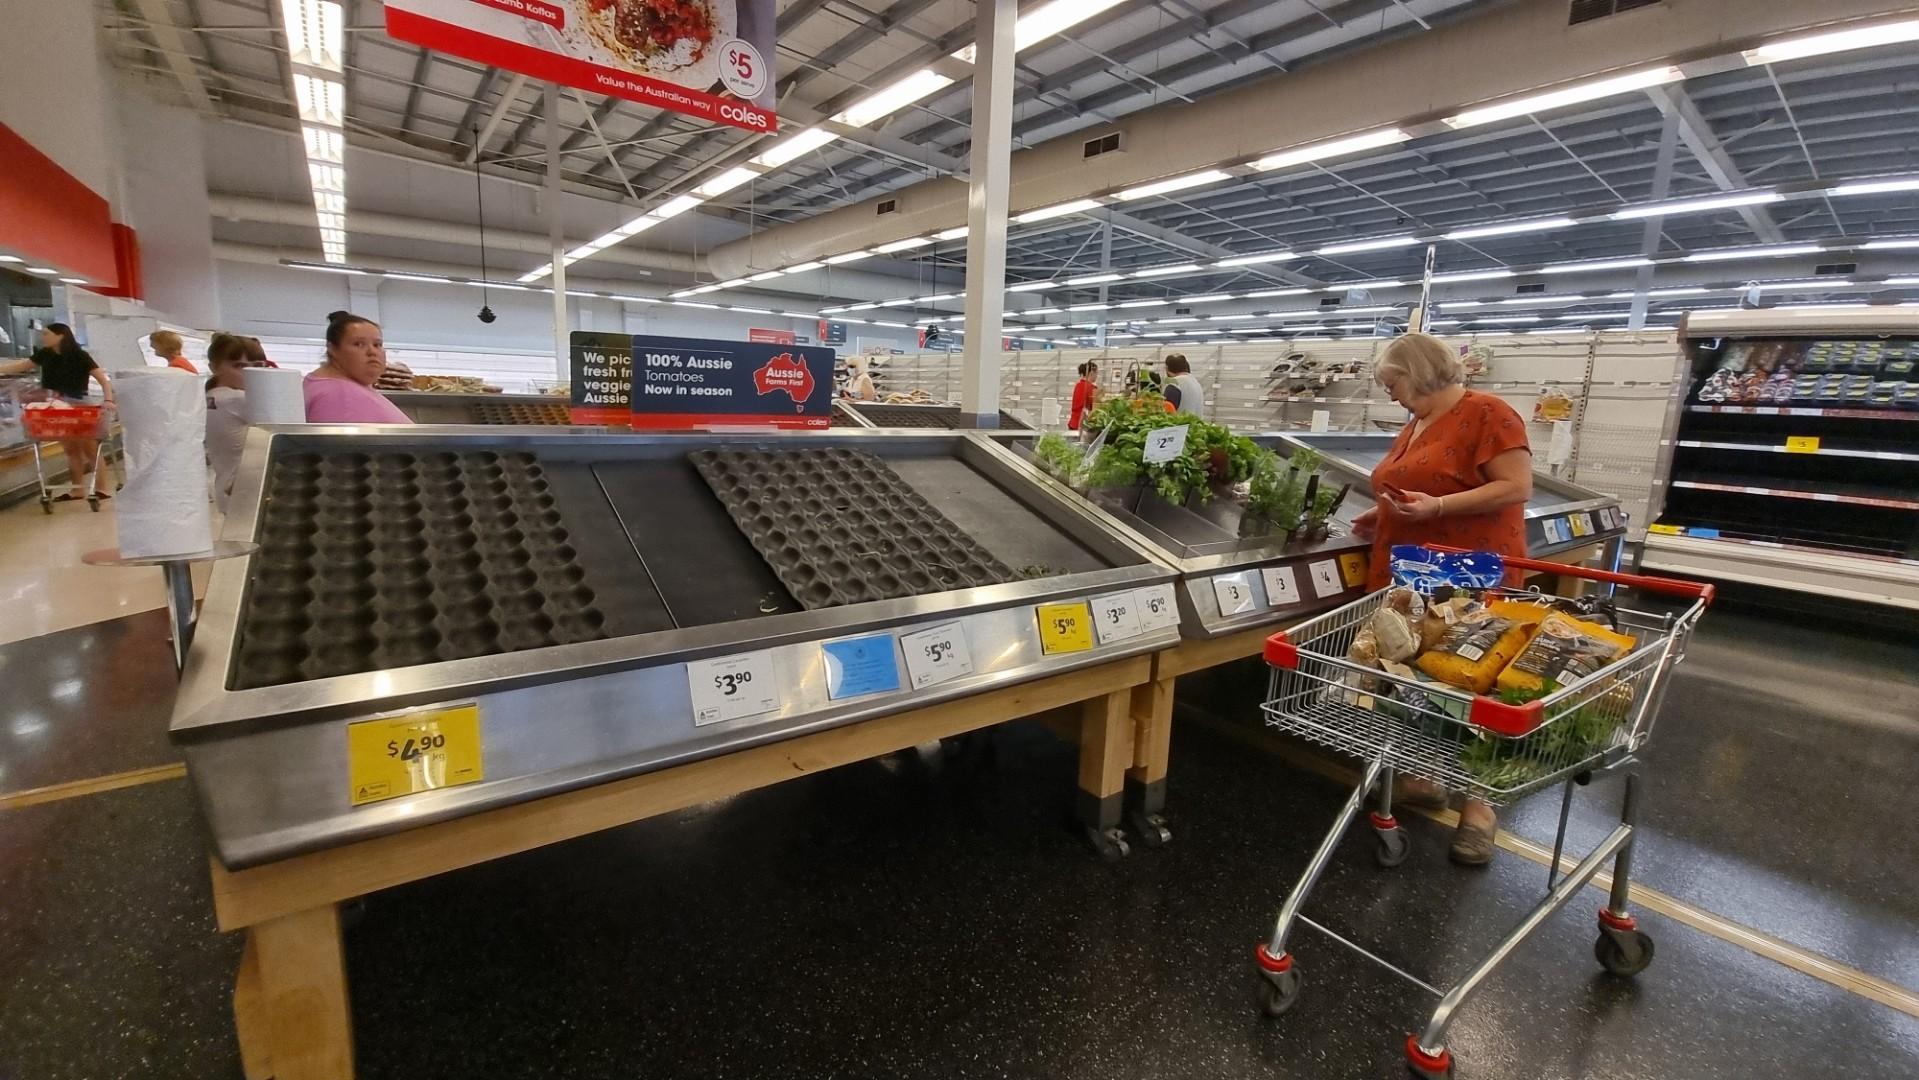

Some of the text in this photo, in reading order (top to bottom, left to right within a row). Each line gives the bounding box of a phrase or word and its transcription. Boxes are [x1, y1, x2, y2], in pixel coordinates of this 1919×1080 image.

[526, 3, 557, 19] Koftas
[729, 49, 753, 79] $5
[595, 73, 711, 112] Value the Australian way
[720, 104, 767, 128] coles
[583, 352, 605, 363] We
[645, 353, 733, 370] 100% Aussie
[583, 365, 617, 377] fresh
[644, 369, 704, 383] Tomatoes
[766, 367, 804, 379] Aussie
[583, 380, 631, 393] veggie
[765, 378, 787, 386] Farms
[644, 384, 733, 396] Now in season
[583, 392, 629, 404] Aussie
